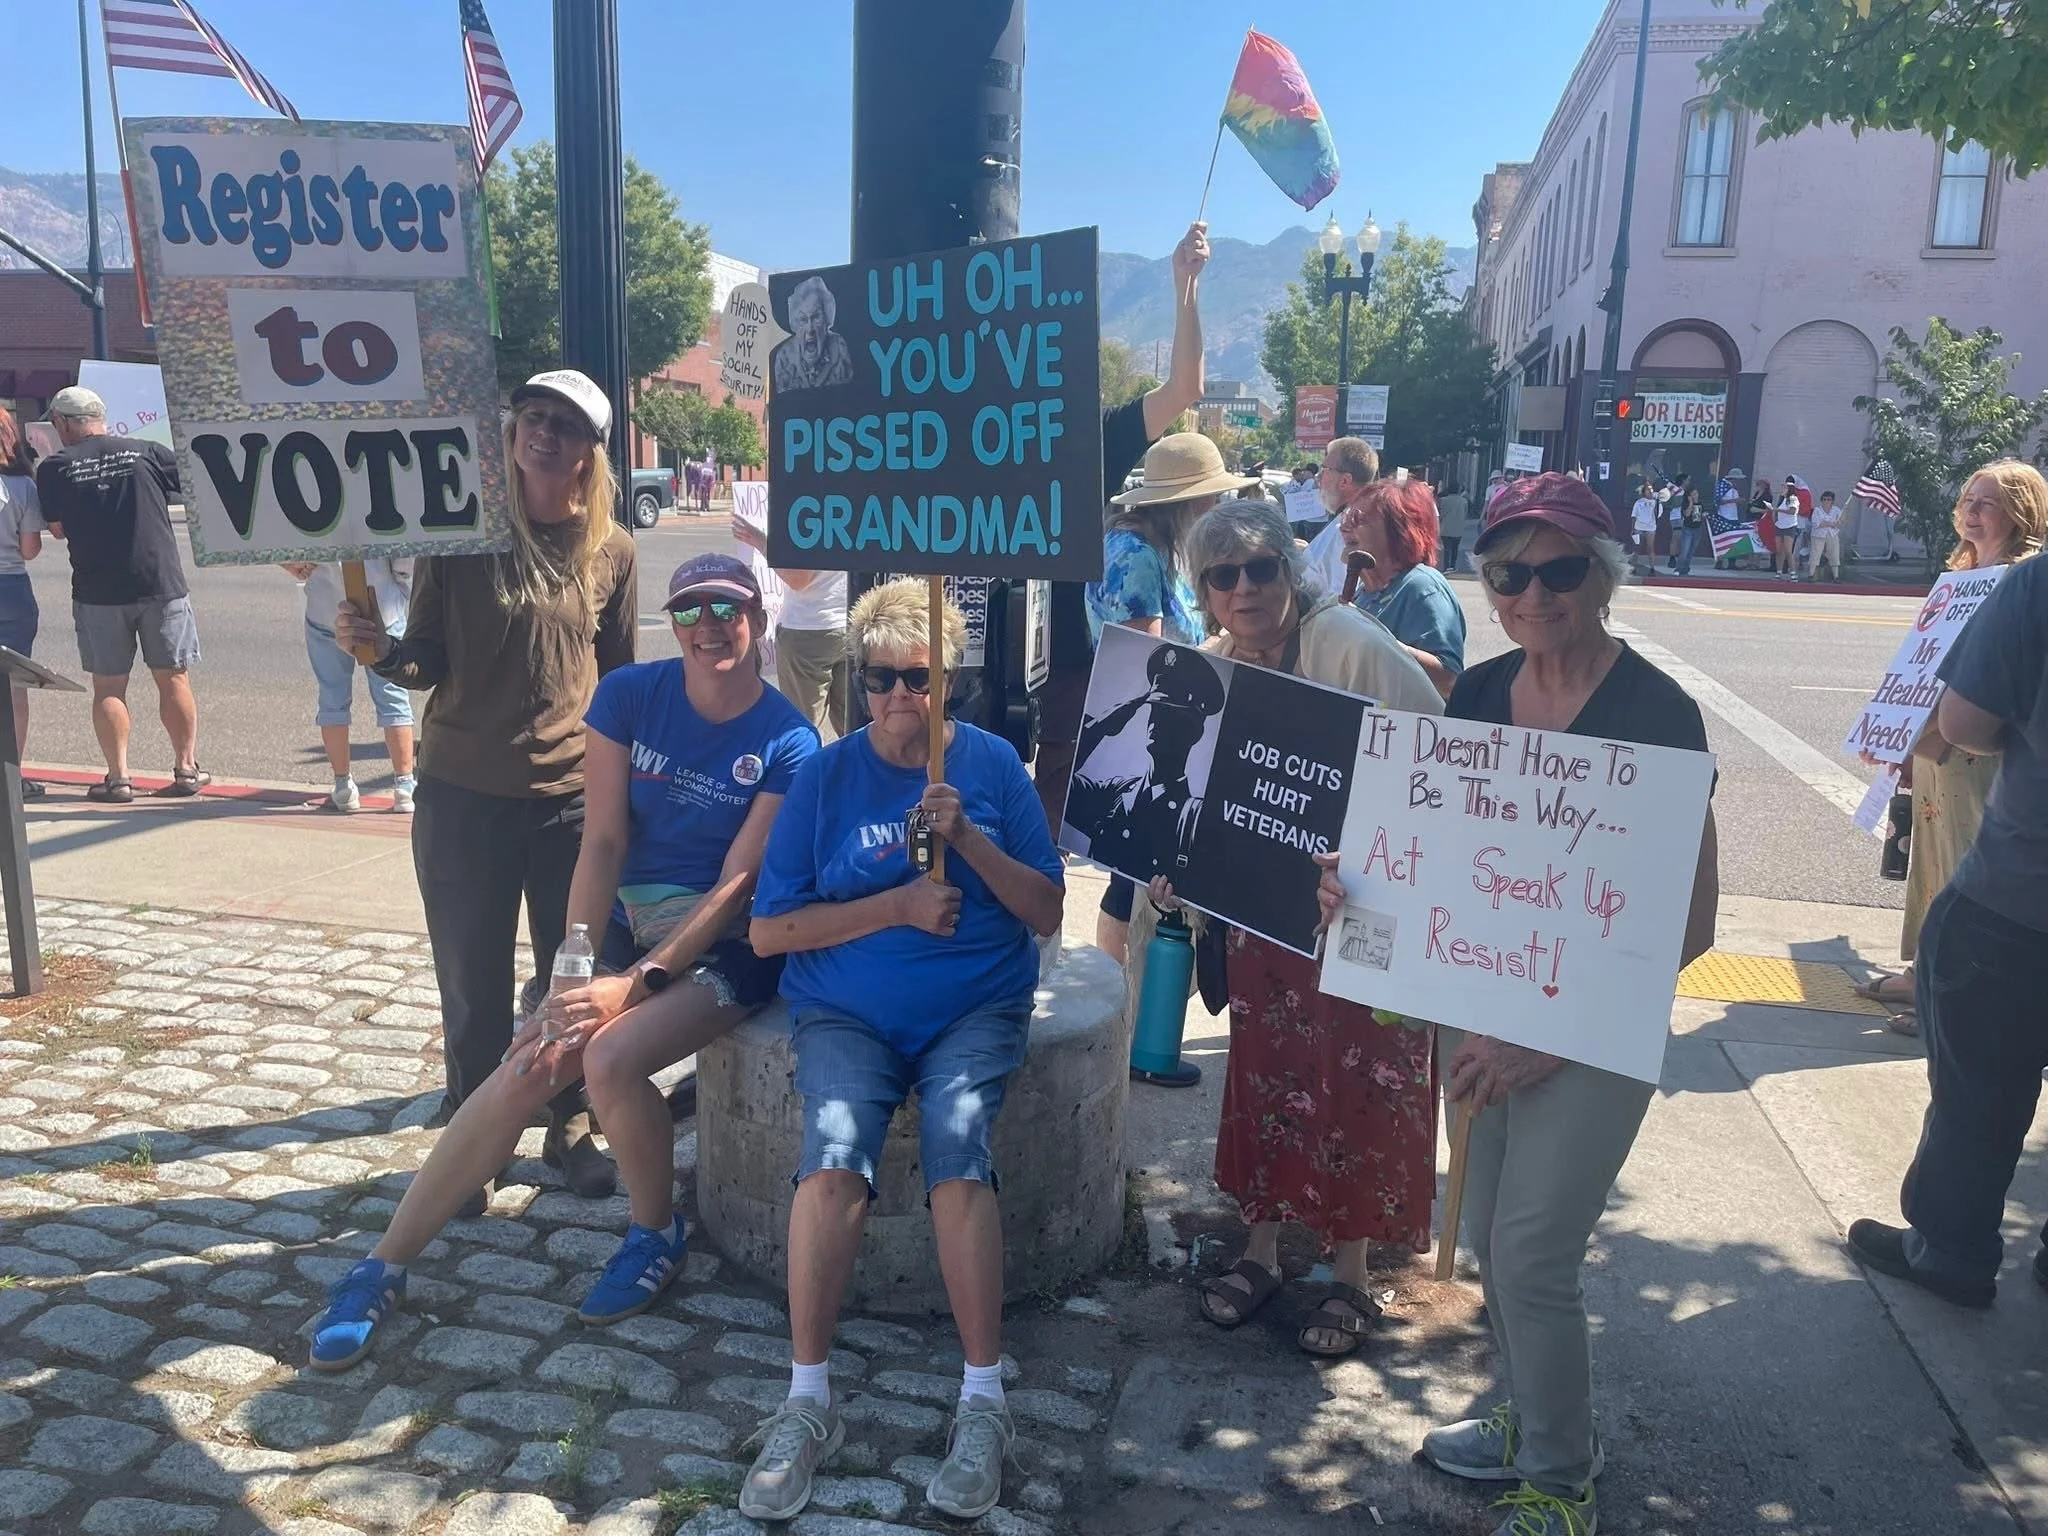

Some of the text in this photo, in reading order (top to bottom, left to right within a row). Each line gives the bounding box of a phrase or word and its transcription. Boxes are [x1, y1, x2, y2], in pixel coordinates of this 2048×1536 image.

[150, 145, 455, 268] Register
[868, 243, 1084, 327] UH OH...
[730, 293, 767, 324] HANDS
[255, 306, 398, 387] to
[736, 340, 754, 358] MY
[737, 323, 757, 338] OFF
[723, 352, 762, 380] SOCIAL
[869, 320, 1063, 397] YOU'VE
[1632, 423, 1723, 440] 801-791-1800
[1644, 402, 1725, 423] OR LEASE
[784, 398, 1065, 473] PISSED OFF
[191, 427, 484, 540] VOTE
[788, 480, 1063, 557] GRANDMA!
[1950, 578, 1997, 600] HANDS
[1946, 602, 1977, 622] OFF!
[1909, 637, 1941, 674] My
[1871, 673, 1938, 709] Health
[1363, 712, 1637, 786] It Doesn't Have To
[1849, 713, 1912, 752] Needs
[676, 766, 727, 790] LEAGUE OF
[1239, 740, 1342, 791] JOB CUTS
[674, 776, 712, 797] WOMEN
[713, 791, 750, 806] VOTER
[1253, 778, 1312, 815] HURT
[1409, 770, 1442, 809] Be
[1458, 775, 1519, 822] This
[859, 822, 906, 849] LWV
[1223, 800, 1329, 856] VETERANS
[1363, 825, 1424, 887] Act
[1472, 846, 1626, 938] Speak Up
[1425, 906, 1567, 983] Resist!
